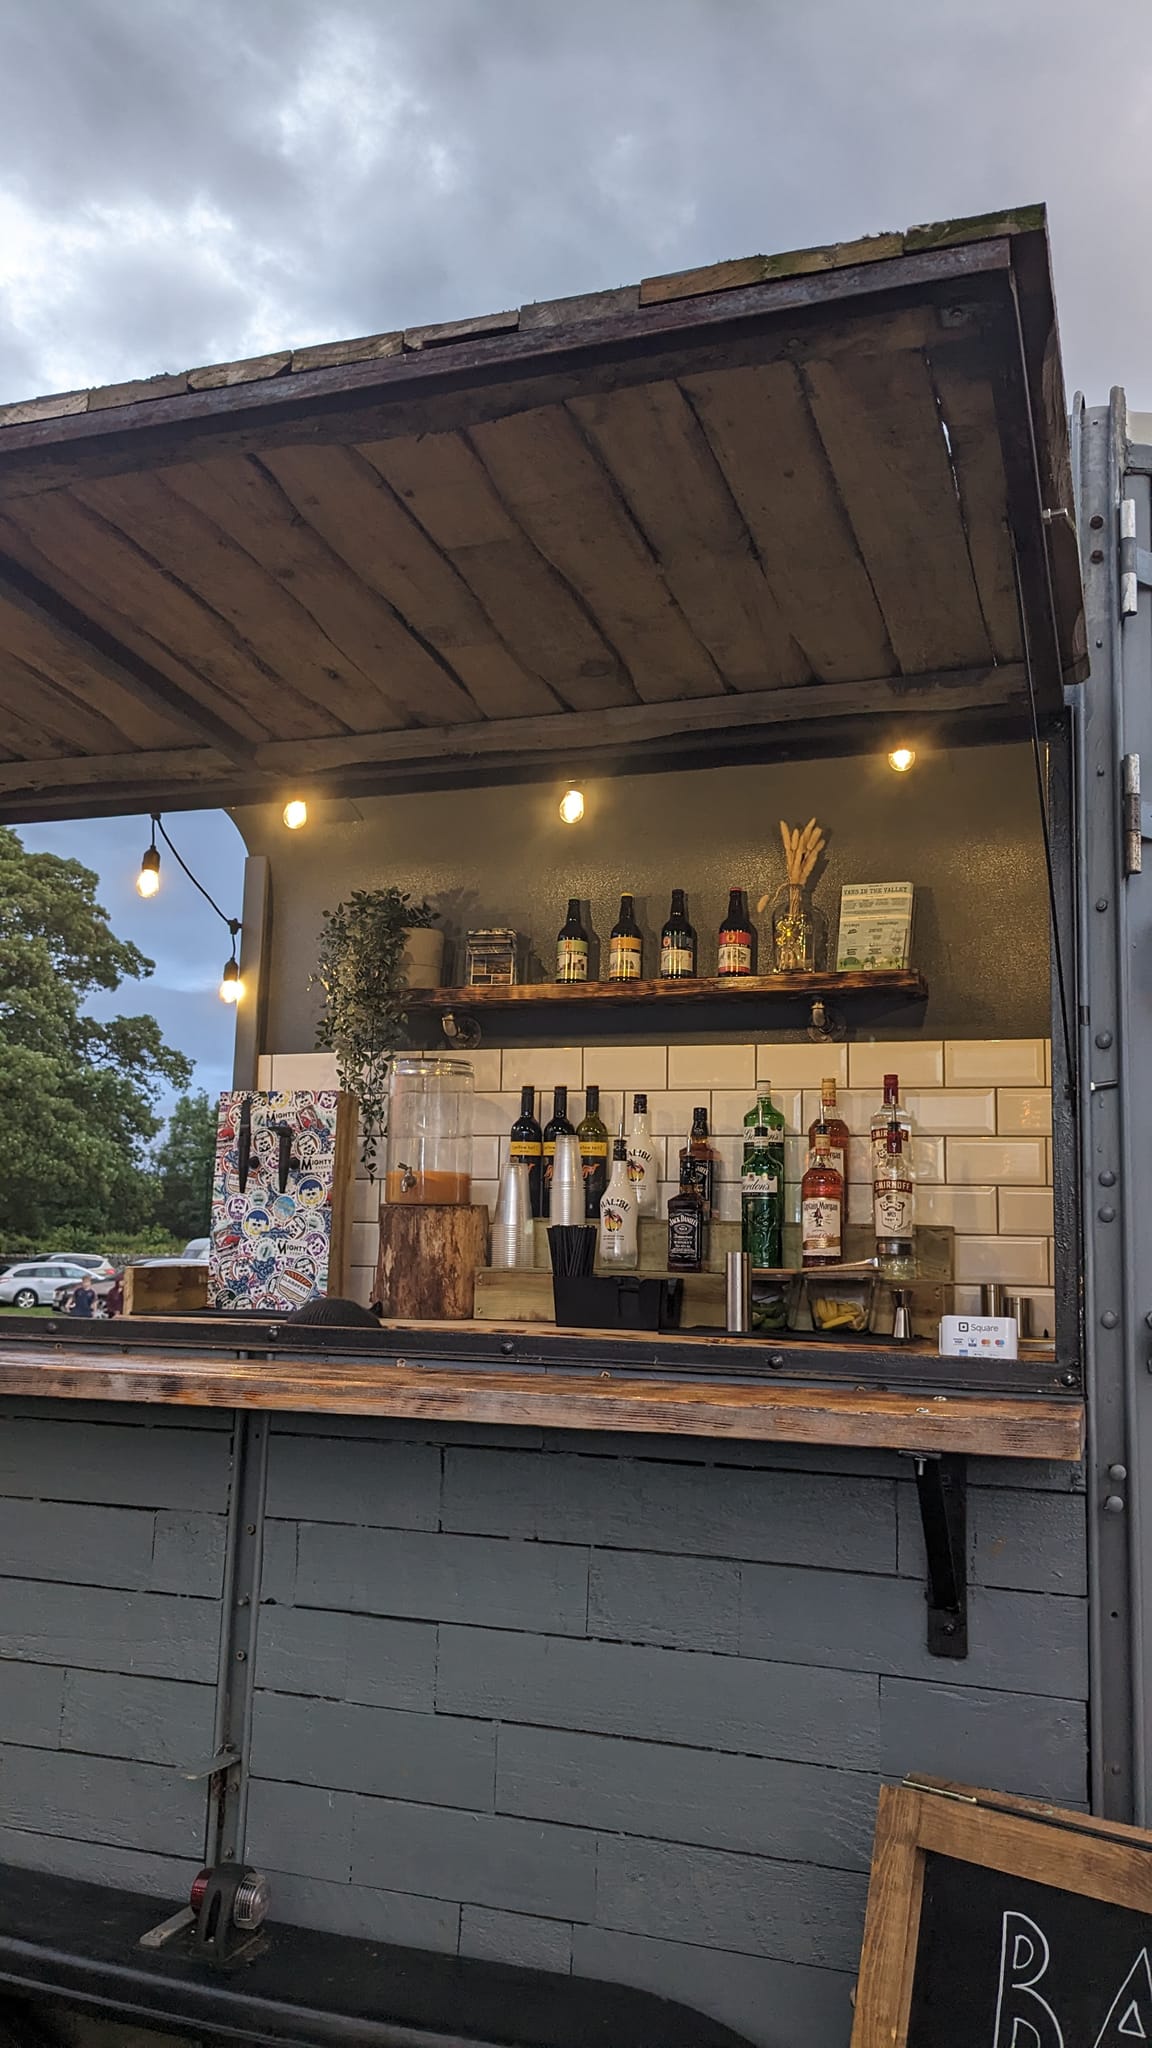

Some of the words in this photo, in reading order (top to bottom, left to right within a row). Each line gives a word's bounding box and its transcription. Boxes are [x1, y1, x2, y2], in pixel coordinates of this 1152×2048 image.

[884, 886, 908, 894] VALLEY
[628, 1148, 653, 1163] ALIBU
[301, 1156, 332, 1171] MIGHTY
[875, 1180, 911, 1192] SMIRNOFF
[600, 1198, 631, 1213] MALIBU
[970, 1323, 999, 1333] Square
